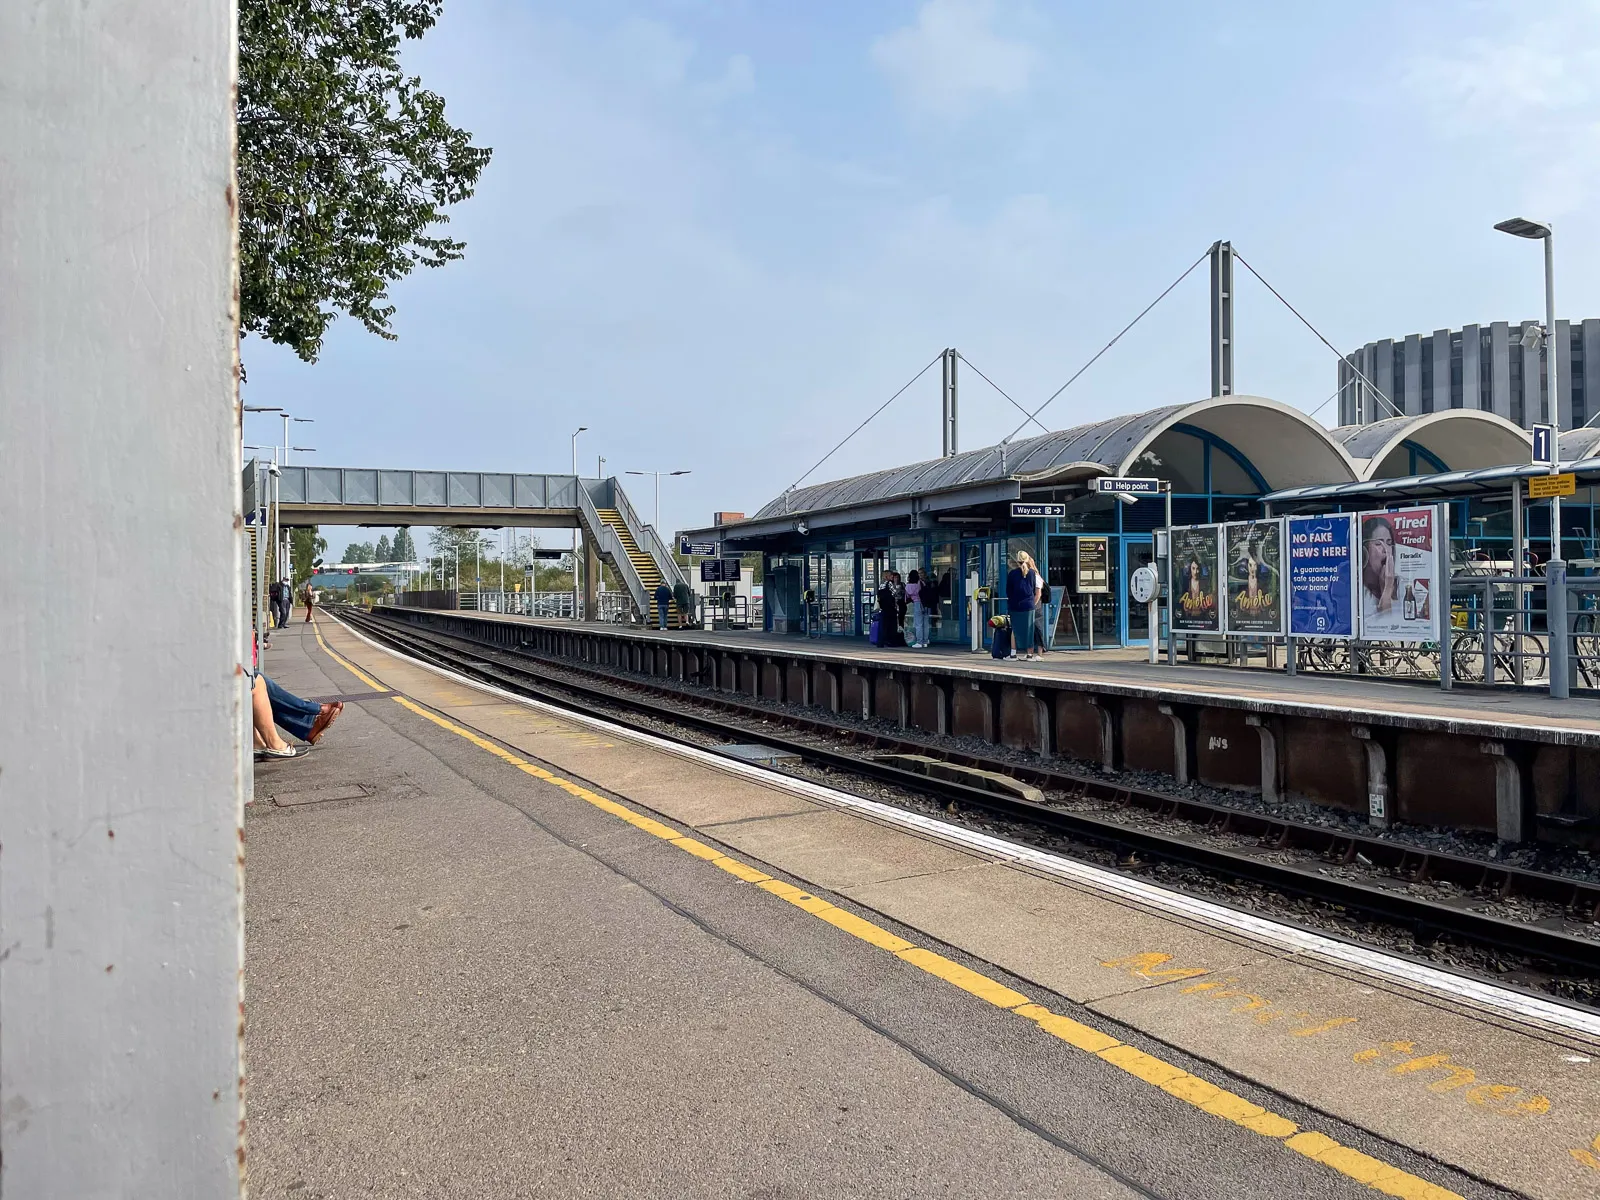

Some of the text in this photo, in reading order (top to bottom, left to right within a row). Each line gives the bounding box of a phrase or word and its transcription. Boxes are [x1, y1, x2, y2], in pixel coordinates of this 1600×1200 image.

[1539, 430, 1546, 460] 1
[1115, 481, 1149, 491] Help point
[1017, 506, 1031, 514] Way
[1394, 515, 1428, 530] Tired
[1292, 532, 1332, 544] NO FAKE
[1402, 535, 1425, 545] Tired?
[1292, 546, 1347, 558] NEWS HERE
[1299, 565, 1338, 575] guaranteed
[1308, 575, 1329, 583] space
[1329, 574, 1339, 582] for
[1293, 583, 1328, 592] your brand
